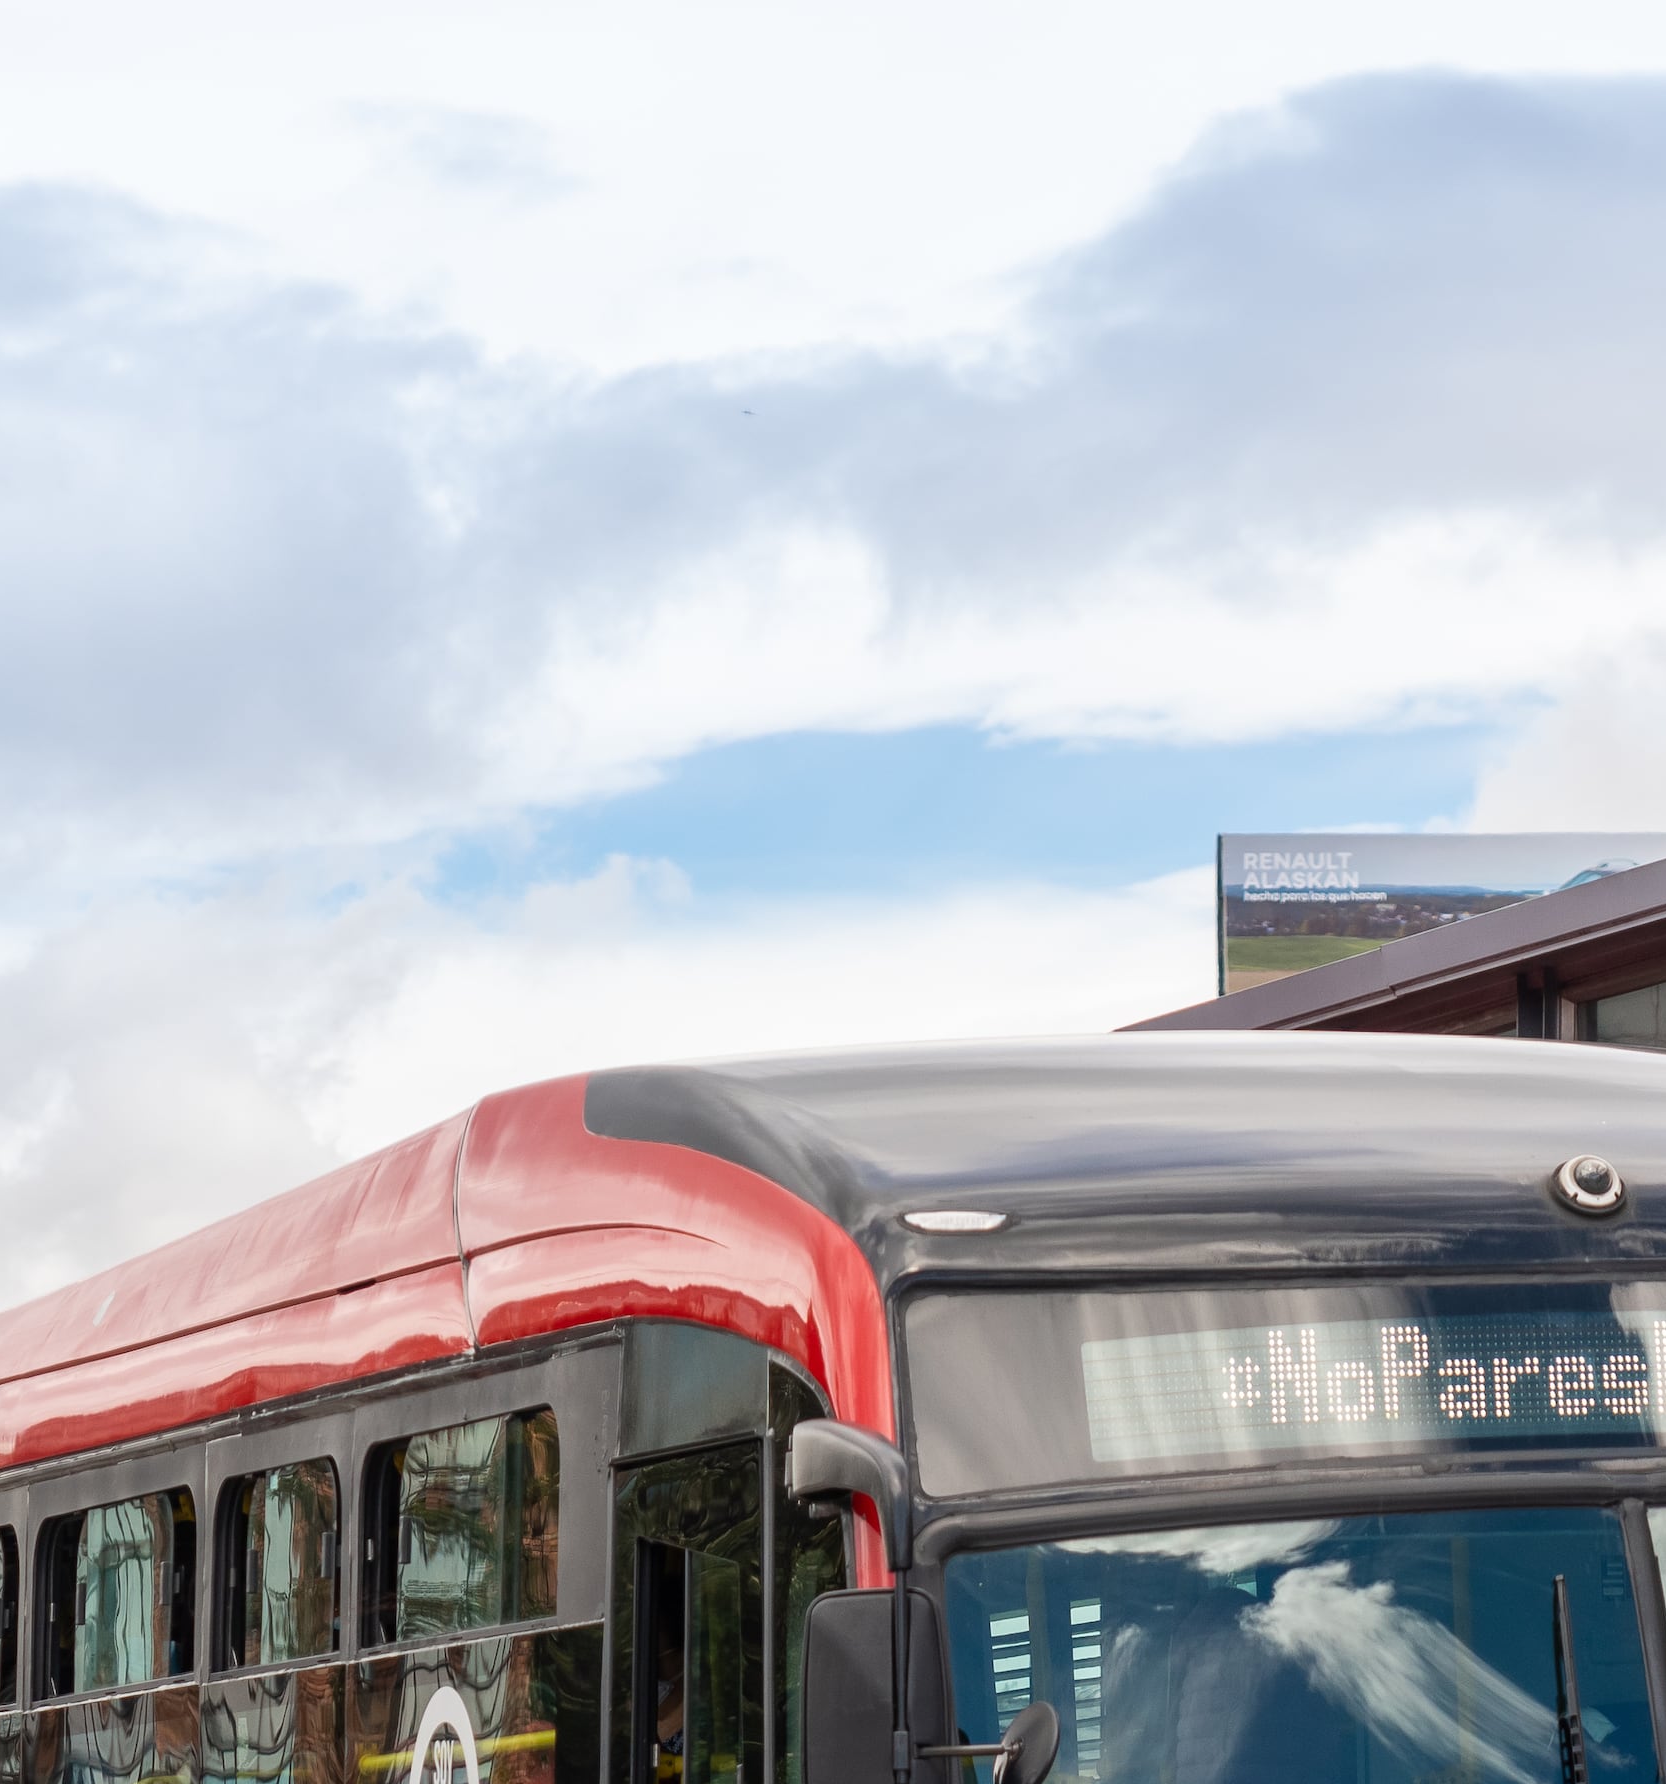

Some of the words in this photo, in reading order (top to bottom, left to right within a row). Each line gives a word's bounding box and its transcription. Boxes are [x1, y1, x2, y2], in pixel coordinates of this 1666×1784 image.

[1243, 852, 1353, 870] RENAULT
[1244, 871, 1359, 889] ALASKAN
[1244, 891, 1280, 901] hecho
[1310, 891, 1326, 901] los
